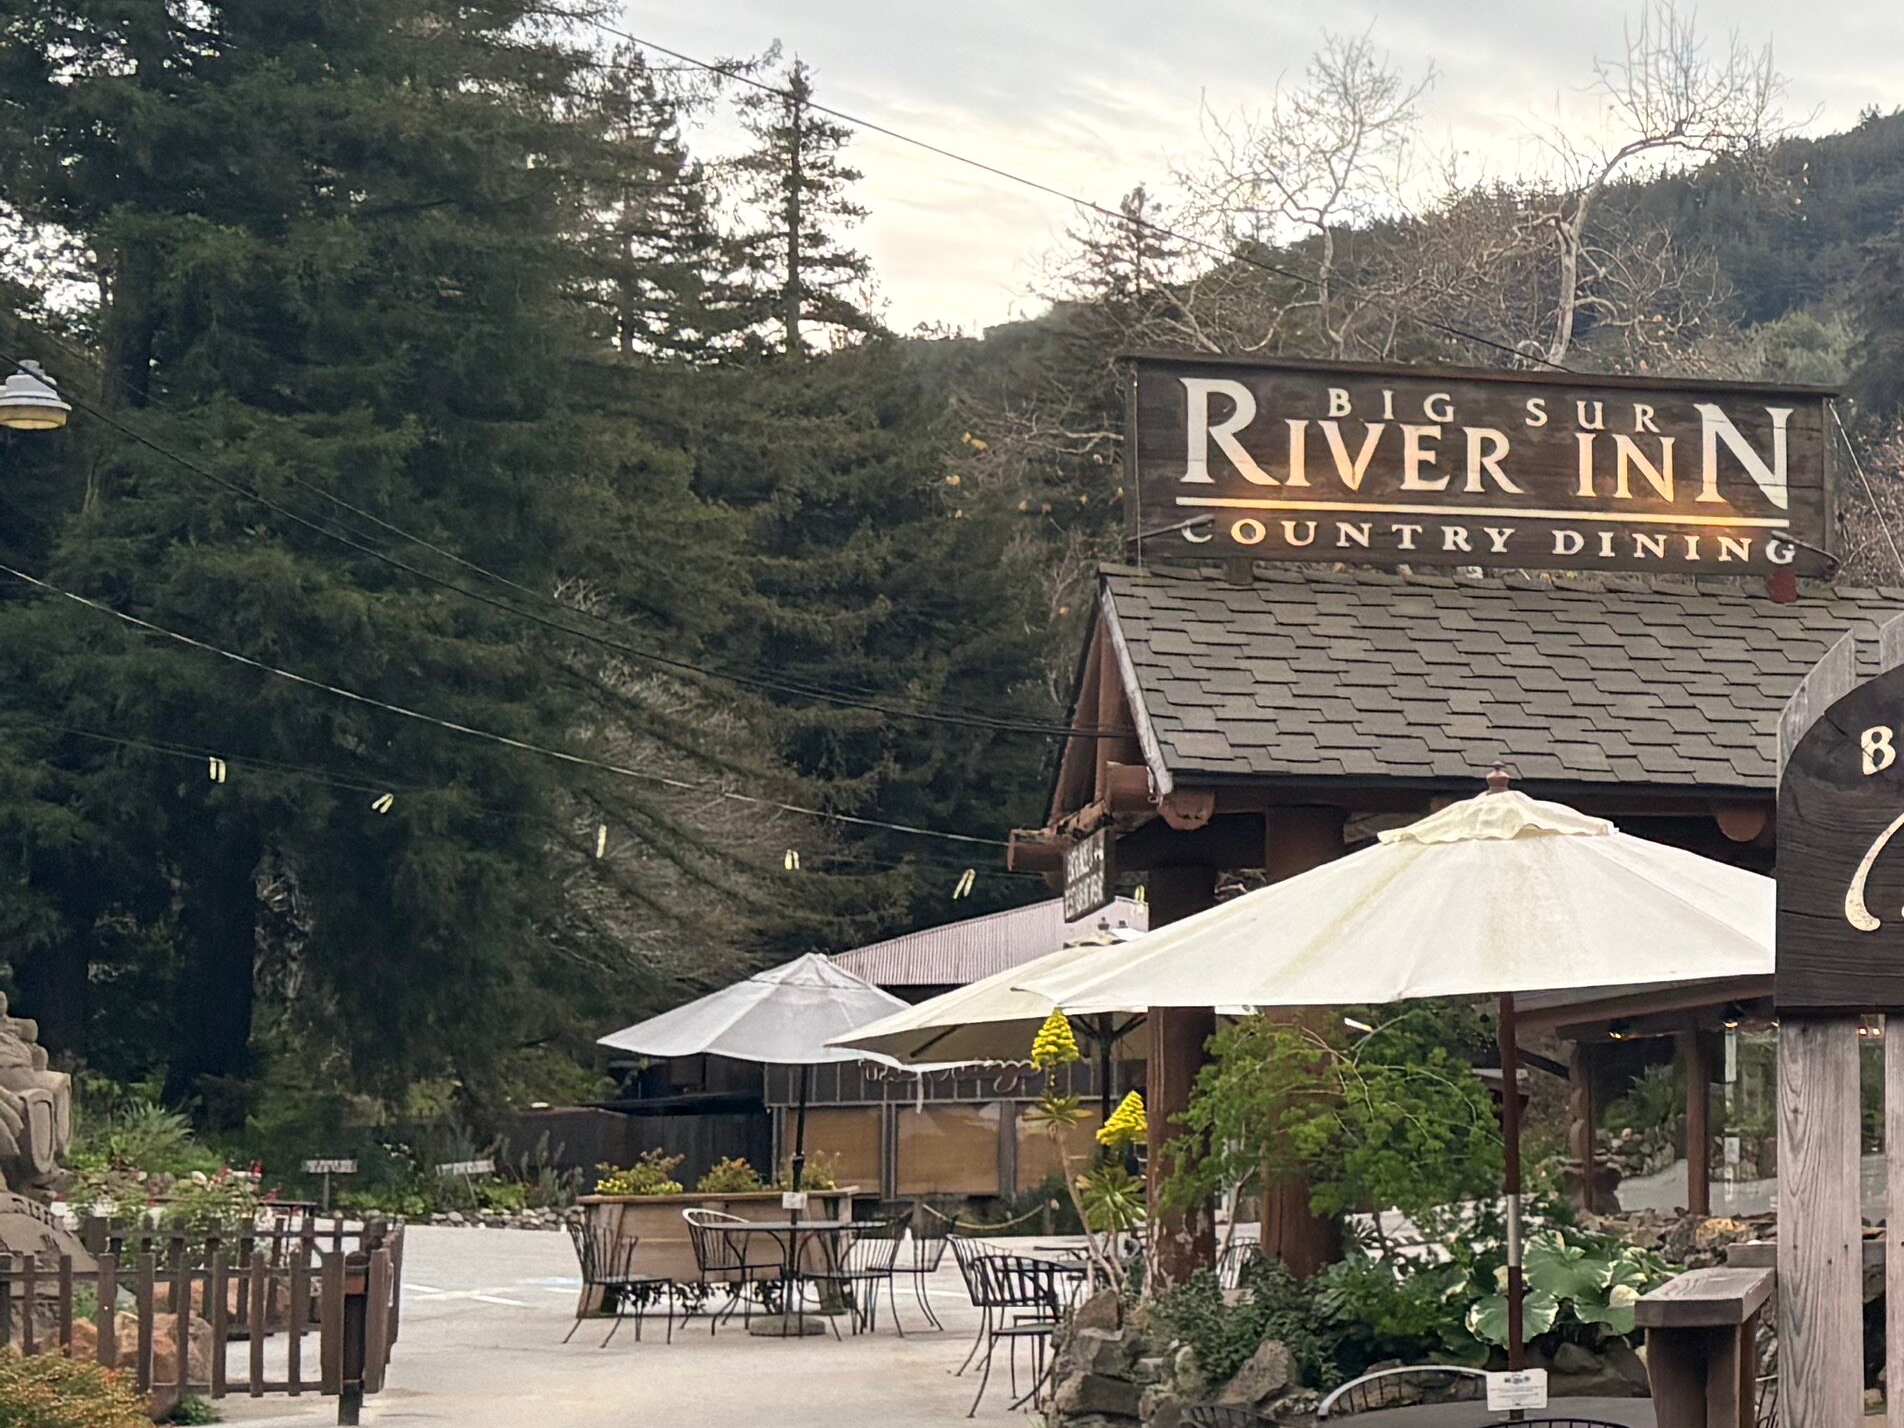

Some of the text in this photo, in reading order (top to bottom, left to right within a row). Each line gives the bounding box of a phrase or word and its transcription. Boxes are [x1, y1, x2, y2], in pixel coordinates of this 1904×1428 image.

[1327, 387, 1661, 433] BIG SUR
[1178, 377, 1793, 510] RIVER INN
[1181, 516, 1797, 565] COUNTRY DINING
